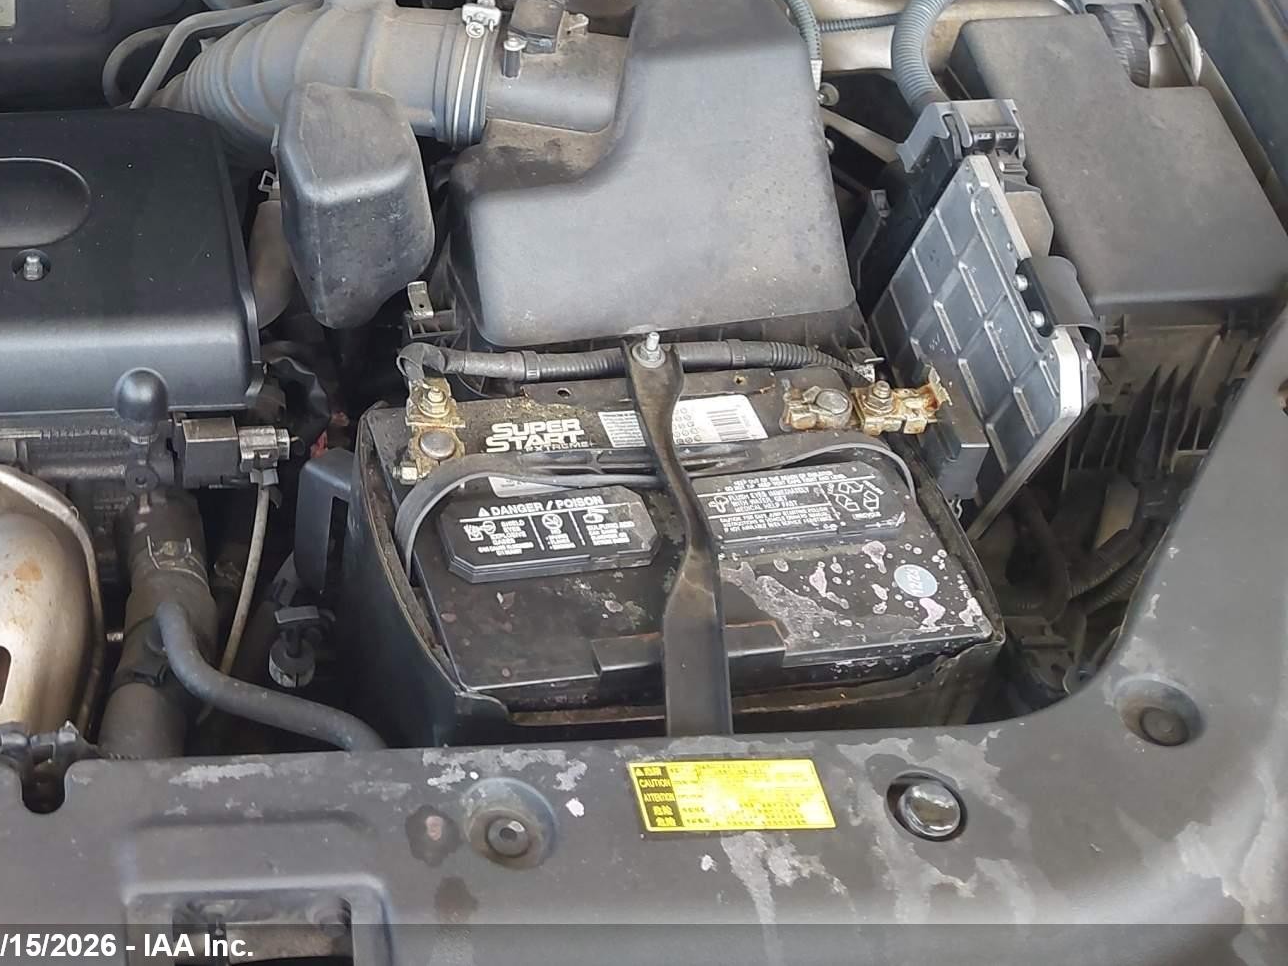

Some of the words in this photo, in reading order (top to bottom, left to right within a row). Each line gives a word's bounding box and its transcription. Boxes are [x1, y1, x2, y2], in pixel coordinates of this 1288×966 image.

[491, 418, 581, 438] SUPER
[485, 430, 585, 453] START
[490, 501, 545, 517] DANGER
[554, 495, 605, 510] POISON
[638, 777, 673, 789] CAUTION
